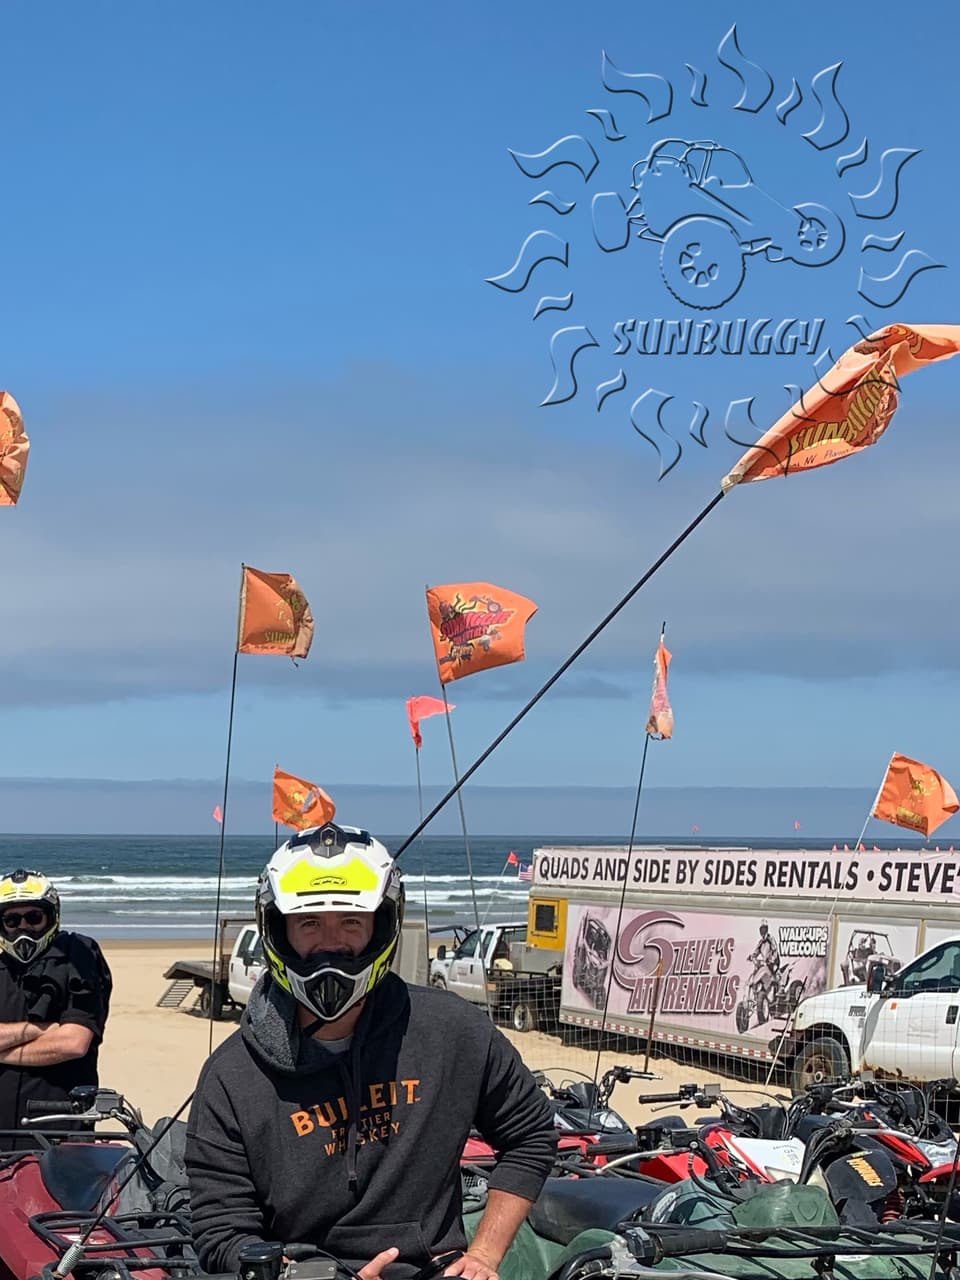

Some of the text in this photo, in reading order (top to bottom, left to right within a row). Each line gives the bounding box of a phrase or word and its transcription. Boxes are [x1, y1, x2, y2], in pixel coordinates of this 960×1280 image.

[539, 855, 589, 881] QUADS
[592, 857, 629, 882] AND
[633, 858, 671, 884] SIDE
[675, 859, 699, 885] BY
[703, 859, 758, 887] SIDES
[763, 860, 860, 891] RENTALS
[612, 910, 736, 989] STEVE'S
[779, 926, 828, 942] WALK-UPS
[779, 941, 827, 957] WELCOME
[661, 975, 741, 1015] RENTALS
[289, 1077, 420, 1137] BULEIT
[323, 1121, 400, 1157] WHSKEY
[331, 1111, 391, 1140] FRTIER
